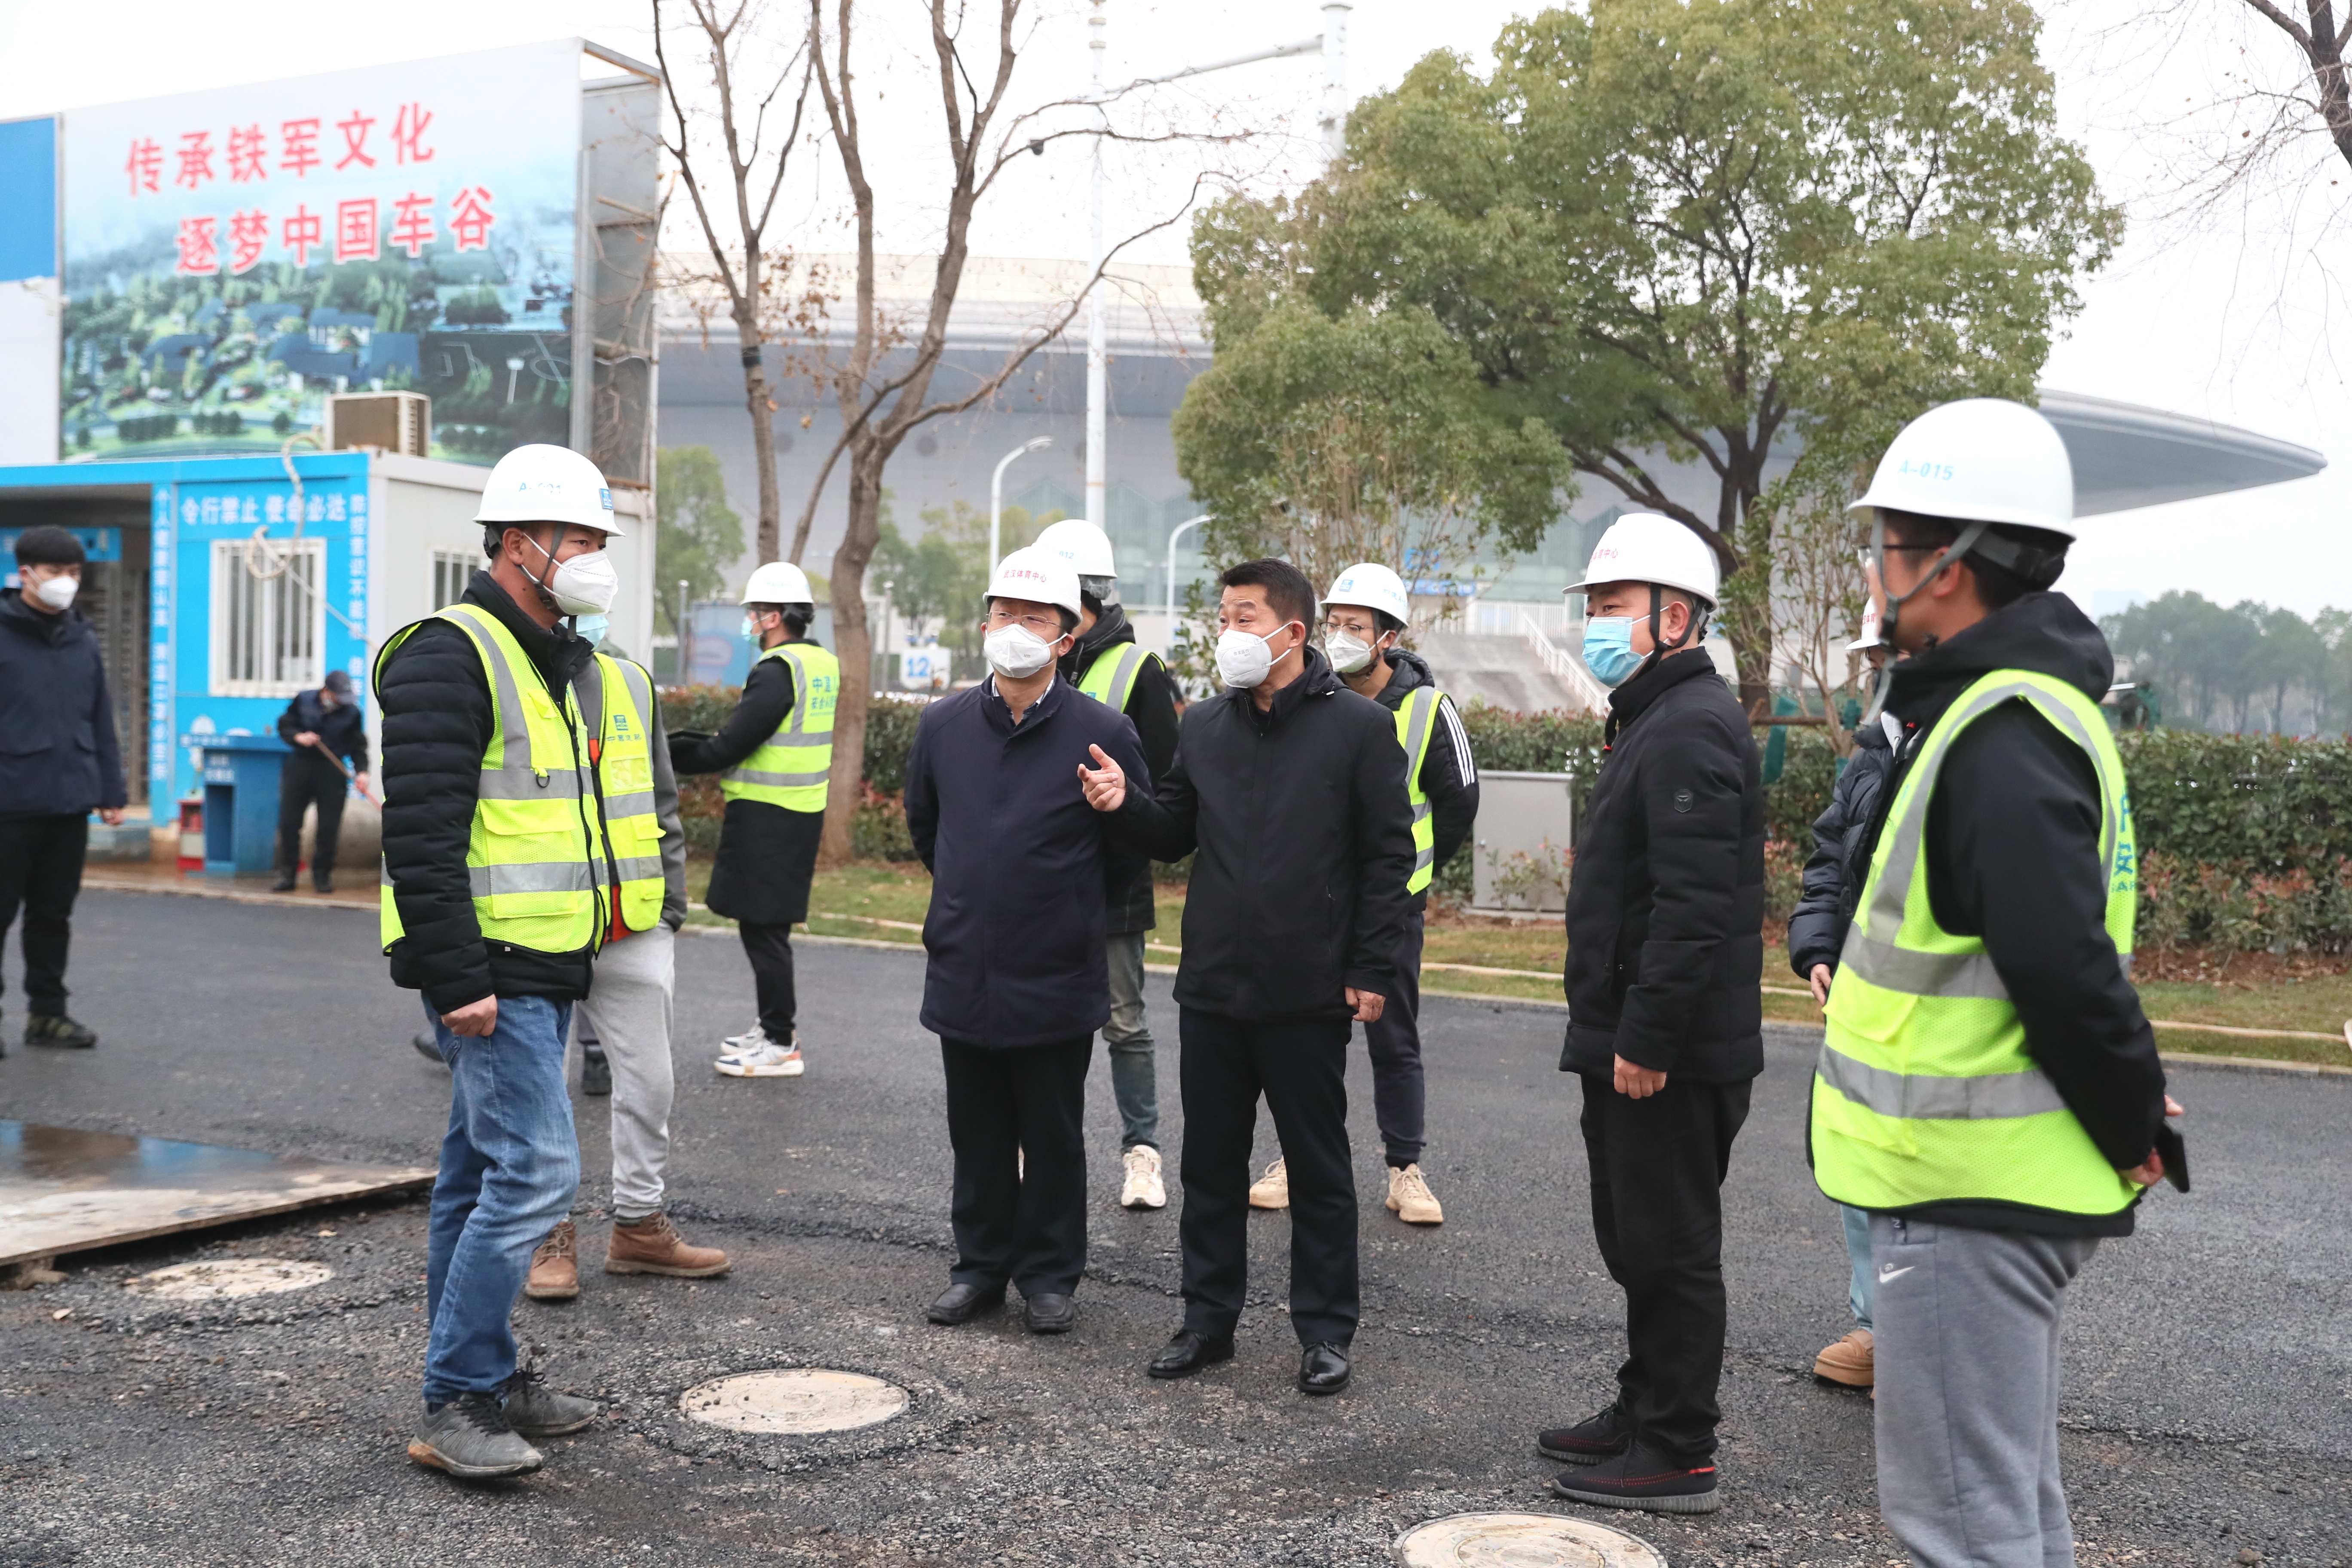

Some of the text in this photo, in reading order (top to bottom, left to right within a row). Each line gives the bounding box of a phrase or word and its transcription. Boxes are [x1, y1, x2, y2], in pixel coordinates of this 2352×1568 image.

[126, 101, 435, 196] 传承铁军文化
[177, 186, 494, 273] 逐梦中国车谷
[1897, 459, 1954, 480] A-015
[1004, 569, 1046, 582] 武汉体育中心
[908, 656, 930, 677] 12
